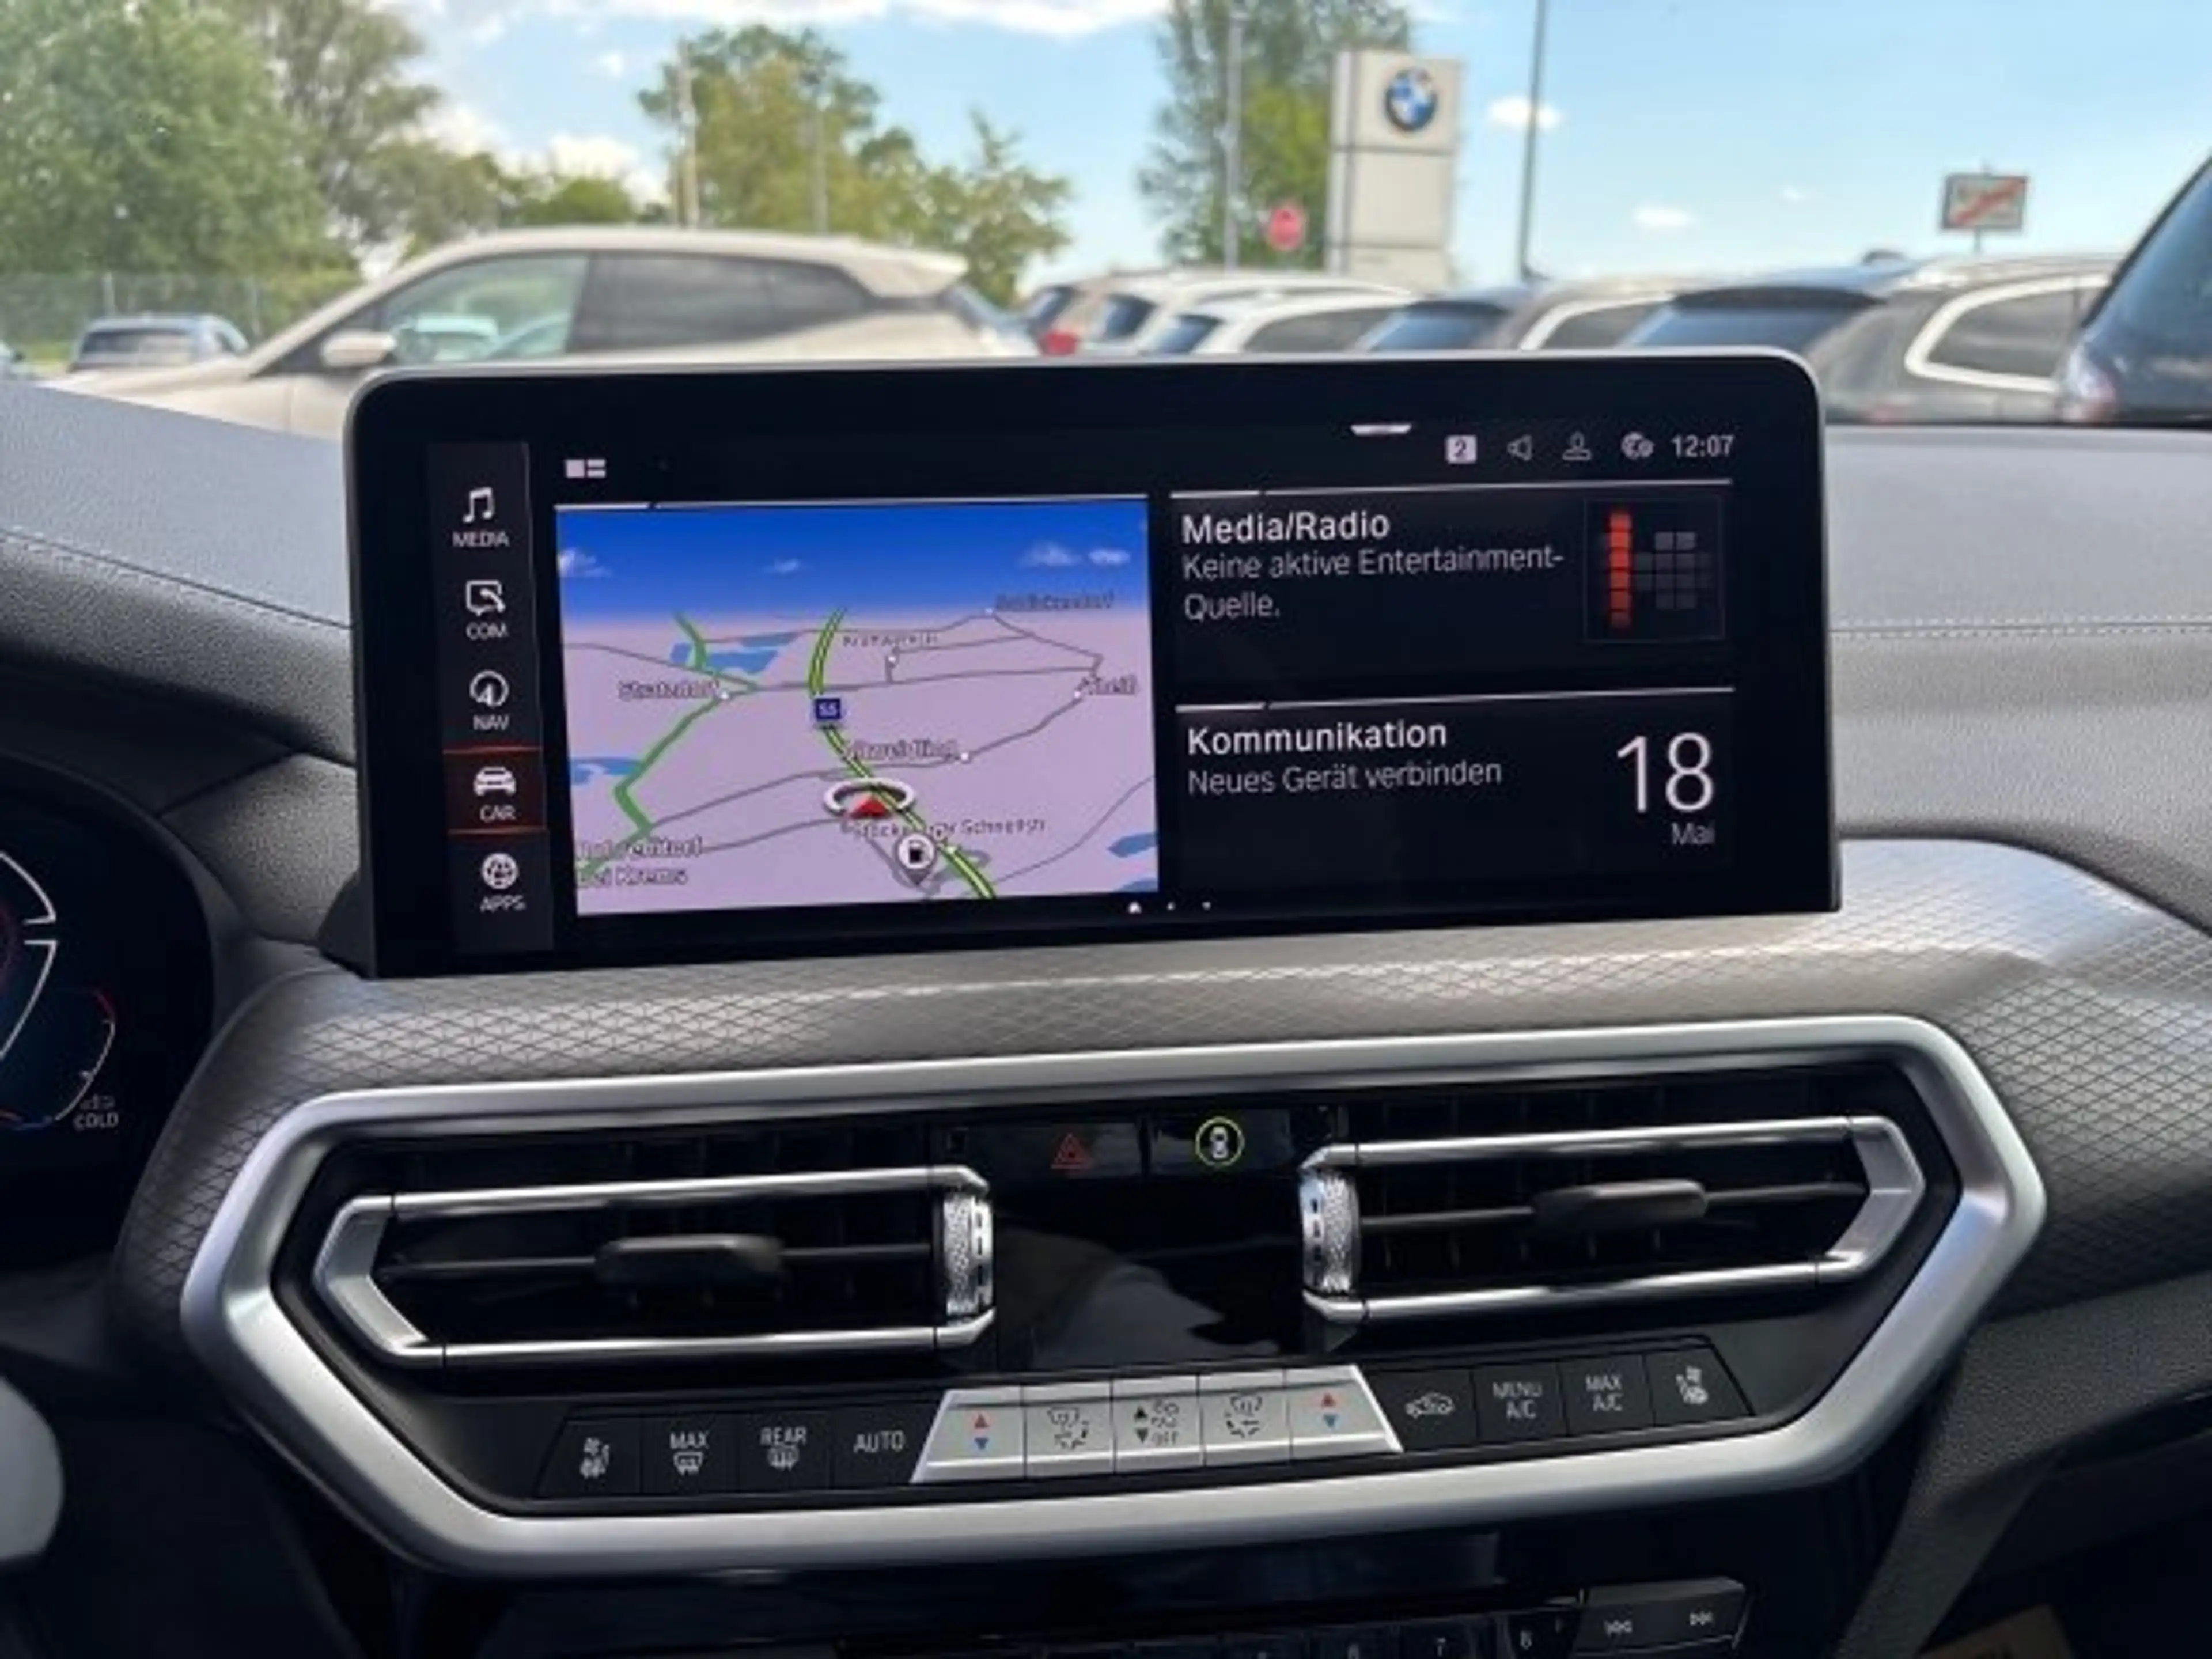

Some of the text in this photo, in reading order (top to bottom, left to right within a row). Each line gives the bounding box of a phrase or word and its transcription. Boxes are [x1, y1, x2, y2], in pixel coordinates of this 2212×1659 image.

[1672, 434, 1734, 459] 12:07
[1183, 510, 1391, 544] Media/Radio
[452, 530, 510, 547] MEDIA
[1183, 544, 1565, 581] Keine aktive Entertainment-
[1184, 591, 1280, 622] Quelle.
[465, 622, 509, 641] COM
[472, 714, 510, 731] NAV
[1187, 720, 1446, 755] Kommunikation
[1187, 759, 1502, 796] Neues Gerät verbinden
[1616, 731, 1714, 813] 18
[479, 804, 517, 823] CAR
[1671, 819, 1716, 846] Mai
[479, 893, 527, 914] APPS
[1492, 1381, 1543, 1400] MENU
[1585, 1373, 1623, 1392] MAX
[1506, 1399, 1537, 1421] A/C
[1592, 1391, 1624, 1412] A/C
[669, 1429, 710, 1450] MAX
[759, 1426, 806, 1447] REAR
[853, 1429, 907, 1454] AUTO
